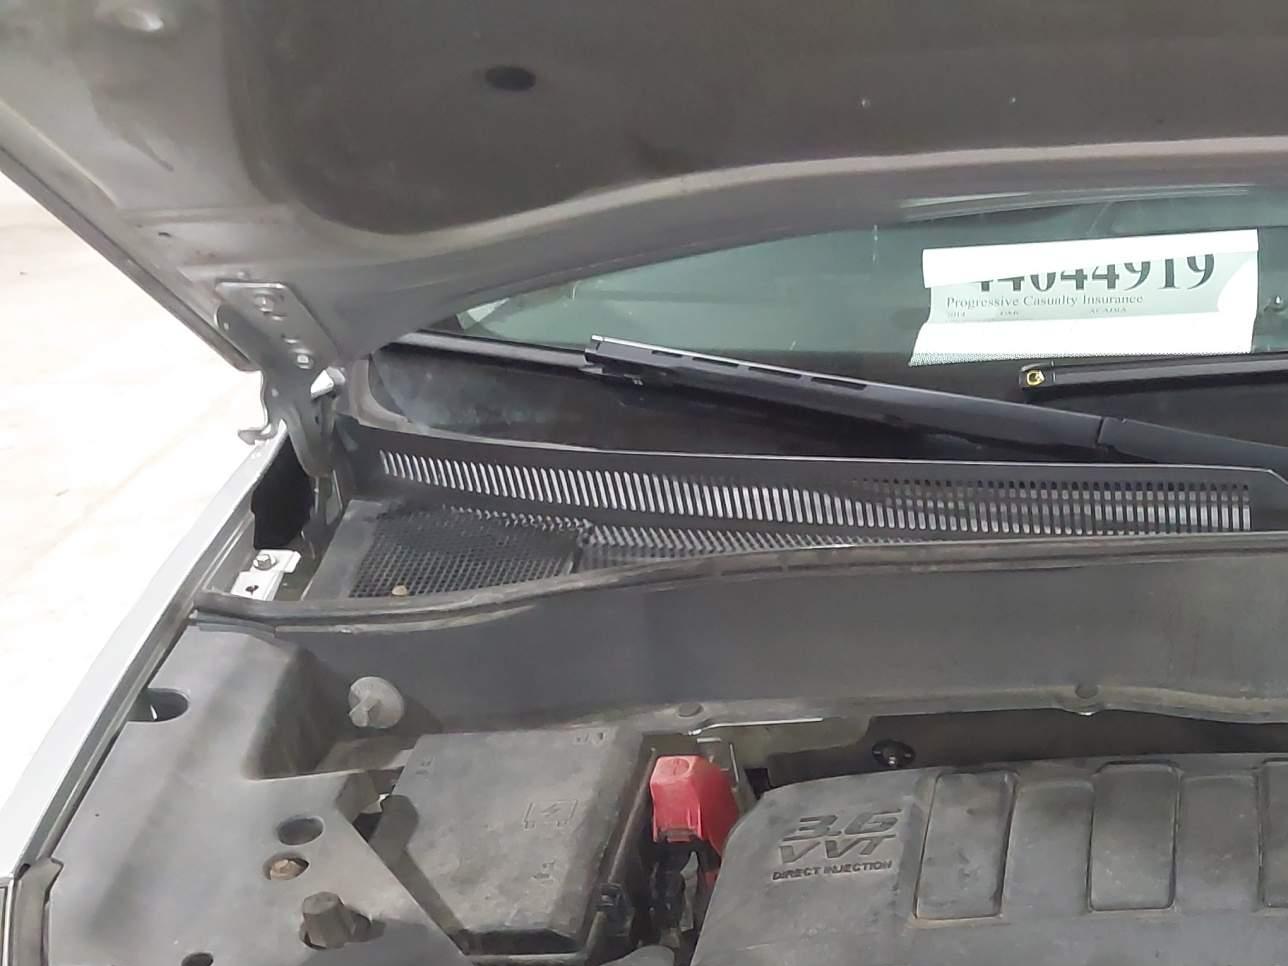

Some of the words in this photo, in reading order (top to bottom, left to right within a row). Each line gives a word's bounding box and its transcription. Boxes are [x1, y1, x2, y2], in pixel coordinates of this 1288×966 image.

[946, 295, 1020, 310] Progressive
[1023, 294, 1078, 309] Casualty
[1082, 292, 1144, 306] Insurance
[782, 808, 903, 842] 3.6
[779, 834, 897, 864] VVT
[772, 866, 821, 881] DIRECT
[823, 859, 893, 875] INJECTION
